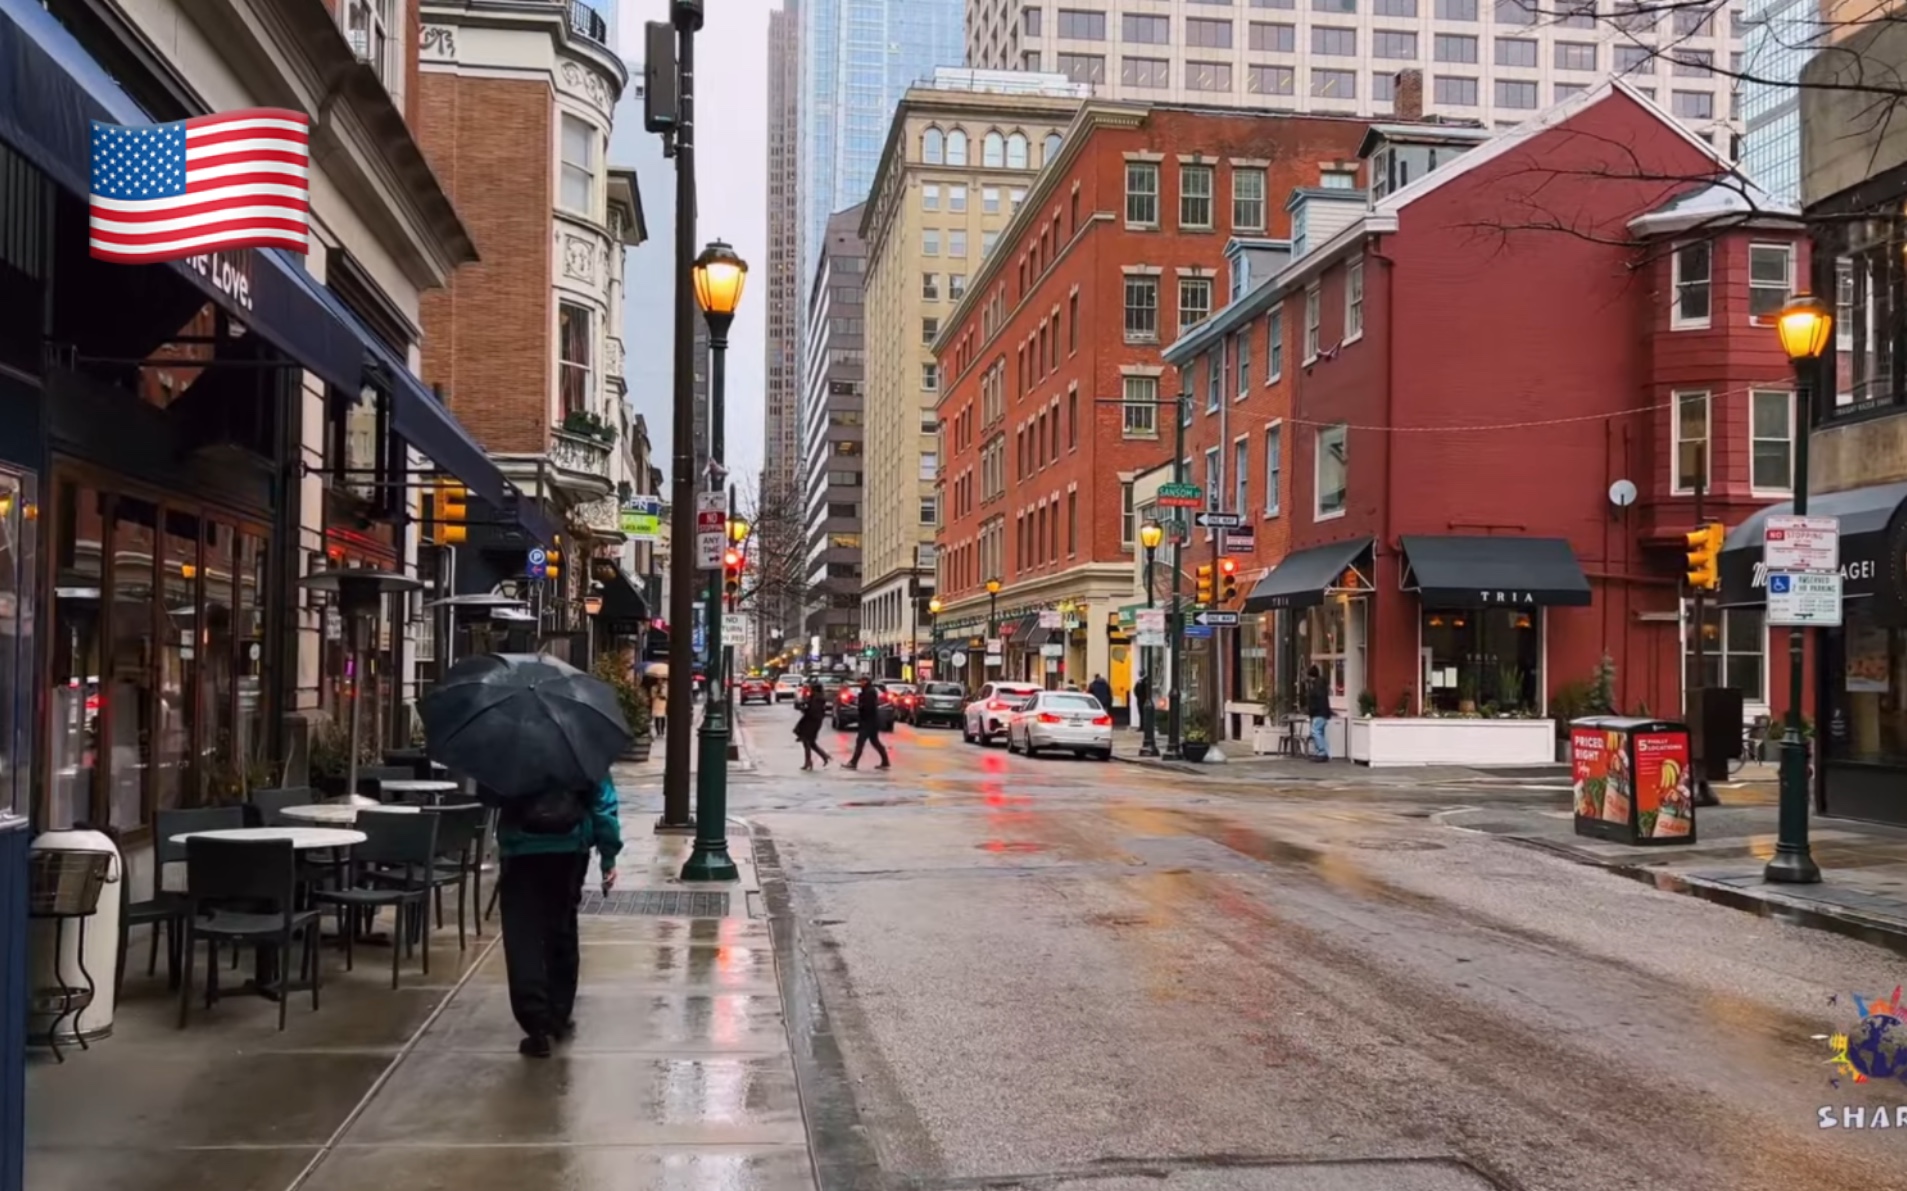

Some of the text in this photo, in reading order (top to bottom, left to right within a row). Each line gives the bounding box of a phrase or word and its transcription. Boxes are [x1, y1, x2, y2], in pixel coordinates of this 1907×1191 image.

[212, 252, 253, 311] Love.
[1159, 487, 1193, 498] SANSOM
[706, 512, 718, 524] NO
[703, 536, 720, 545] ANY
[1770, 531, 1824, 540] NO STOPPING
[703, 546, 720, 554] TIME
[1809, 585, 1836, 593] PARKING
[1480, 591, 1533, 602] TRIA
[725, 616, 738, 624] NO
[1466, 653, 1498, 661] TRIA
[1574, 736, 1604, 748] PRICED
[1638, 740, 1648, 752] 5
[1575, 749, 1600, 761] RIGHT
